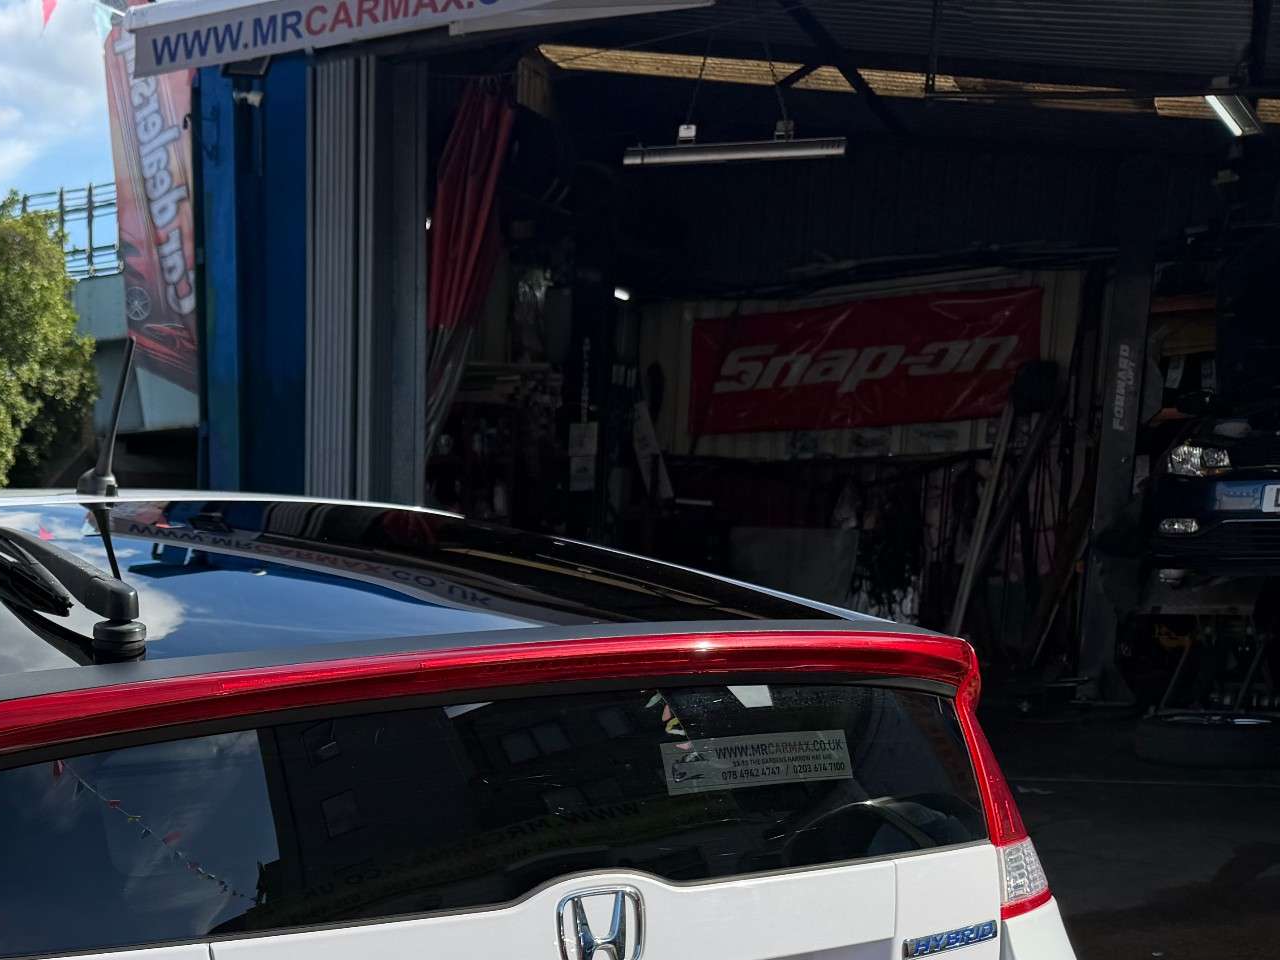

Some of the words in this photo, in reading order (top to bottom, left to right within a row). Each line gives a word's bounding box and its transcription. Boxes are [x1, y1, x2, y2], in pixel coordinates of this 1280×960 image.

[151, 0, 498, 67] WWW.MRCARMA.
[713, 335, 1019, 393] Snap-on
[1112, 344, 1130, 431] FORWARD
[911, 921, 995, 956] HYBRID
